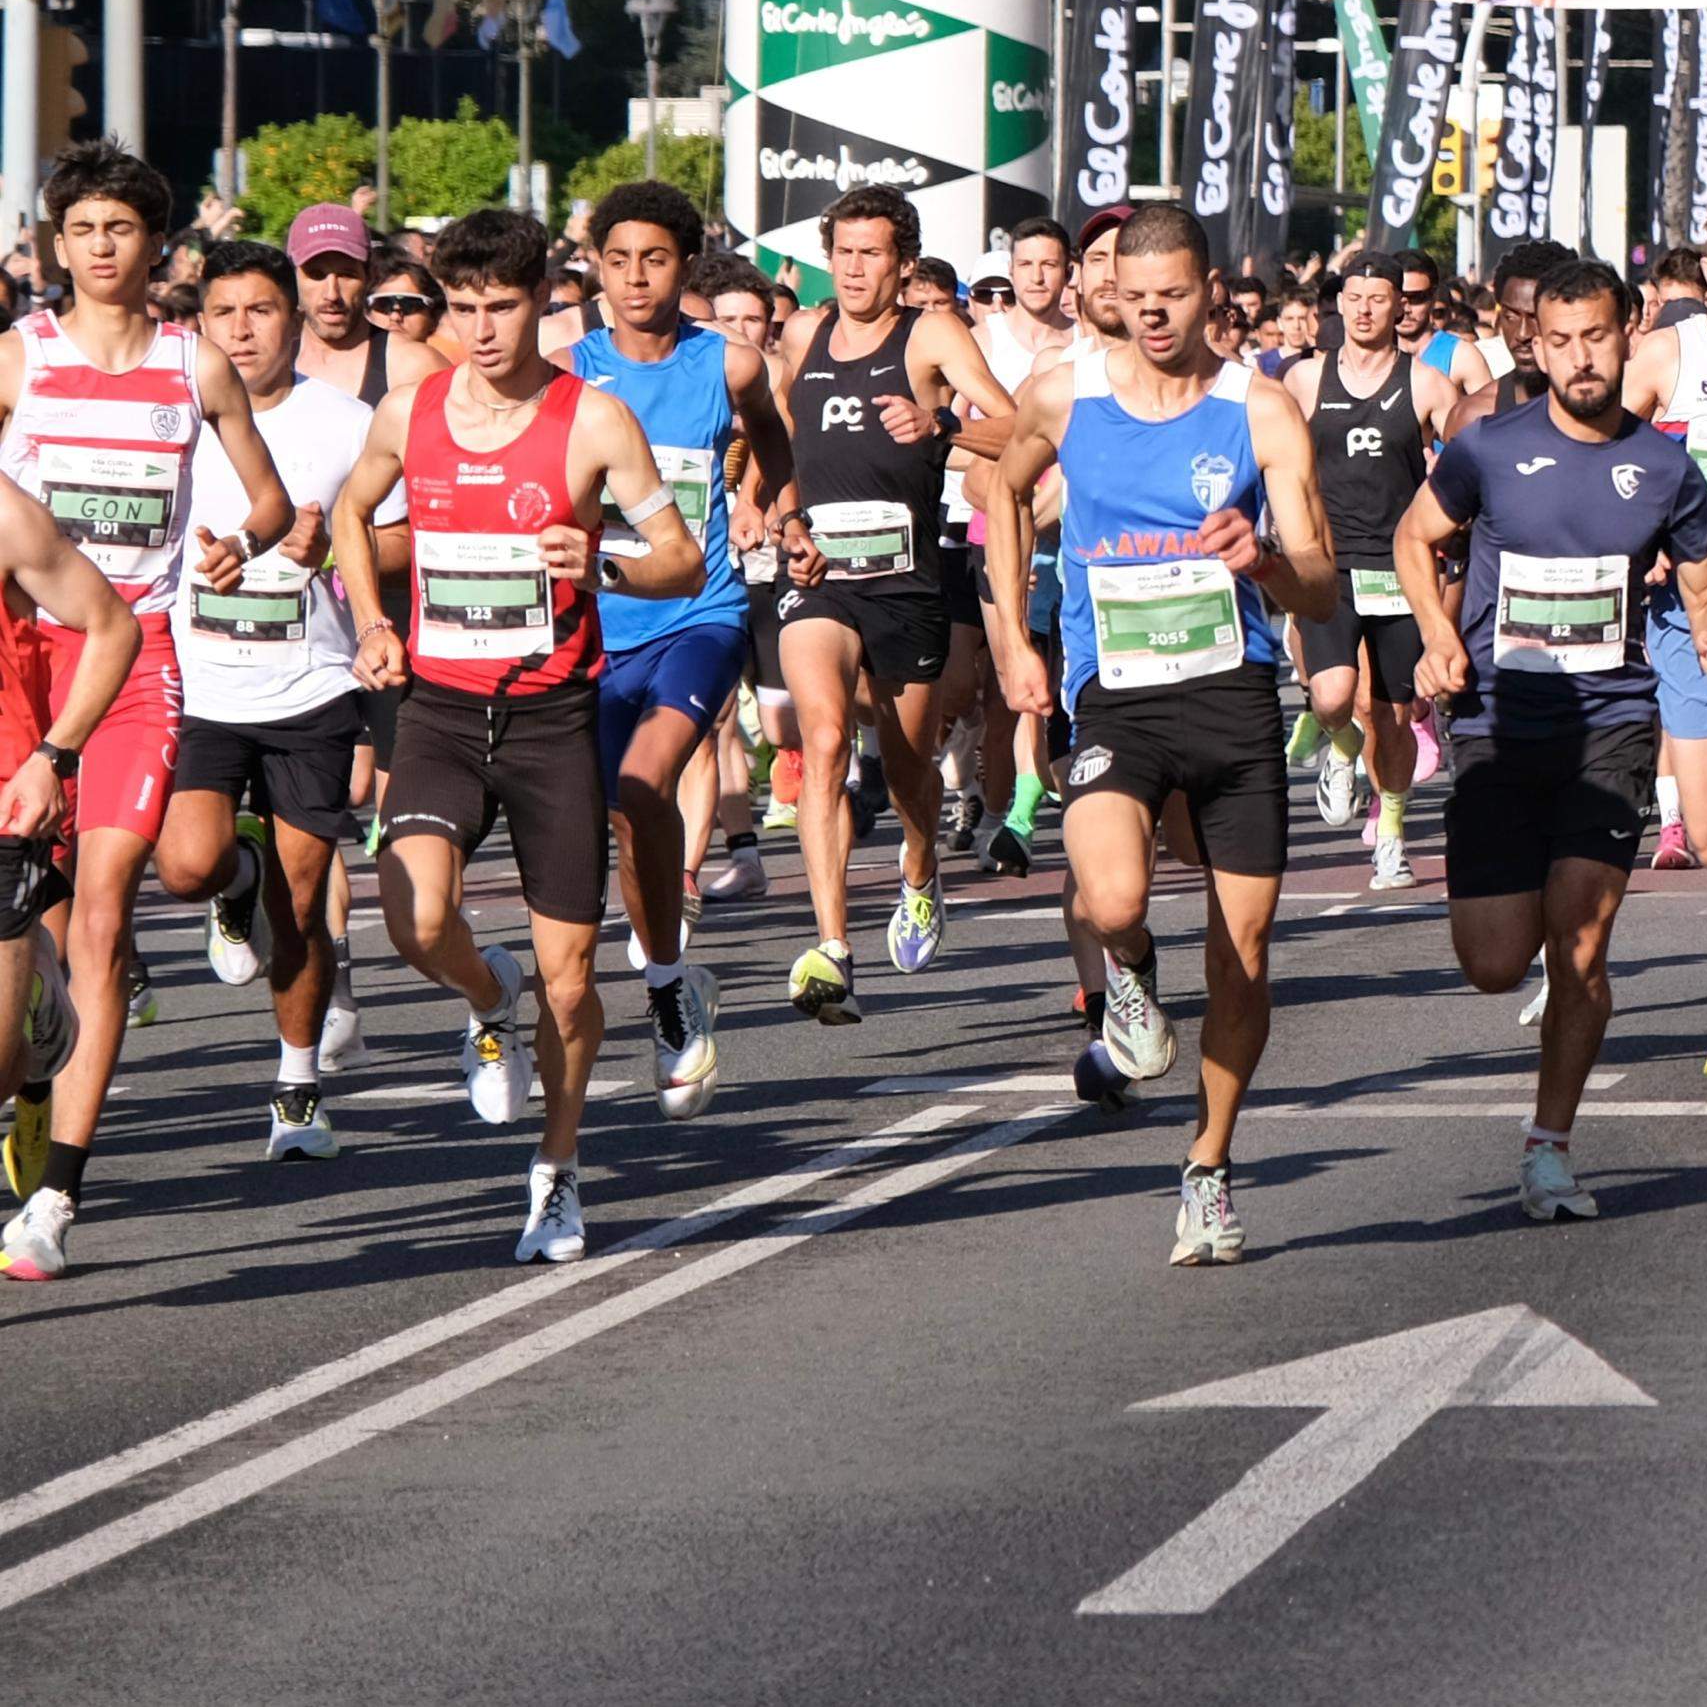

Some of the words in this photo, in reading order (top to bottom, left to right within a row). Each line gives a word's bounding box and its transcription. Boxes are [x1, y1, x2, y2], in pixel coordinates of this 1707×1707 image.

[761, 1, 781, 34] El
[781, 3, 837, 35] Corte
[1084, 5, 1131, 146] Corte
[1203, 30, 1243, 157] Corte
[1391, 63, 1447, 179] Corte
[760, 146, 780, 180] El
[779, 150, 835, 182] Corte
[1077, 145, 1130, 207] El
[81, 497, 144, 521] GON
[93, 520, 119, 536] 101
[236, 620, 256, 633] 88
[464, 606, 493, 620] 123
[1147, 629, 1190, 647] 2055
[1551, 624, 1573, 638] 82
